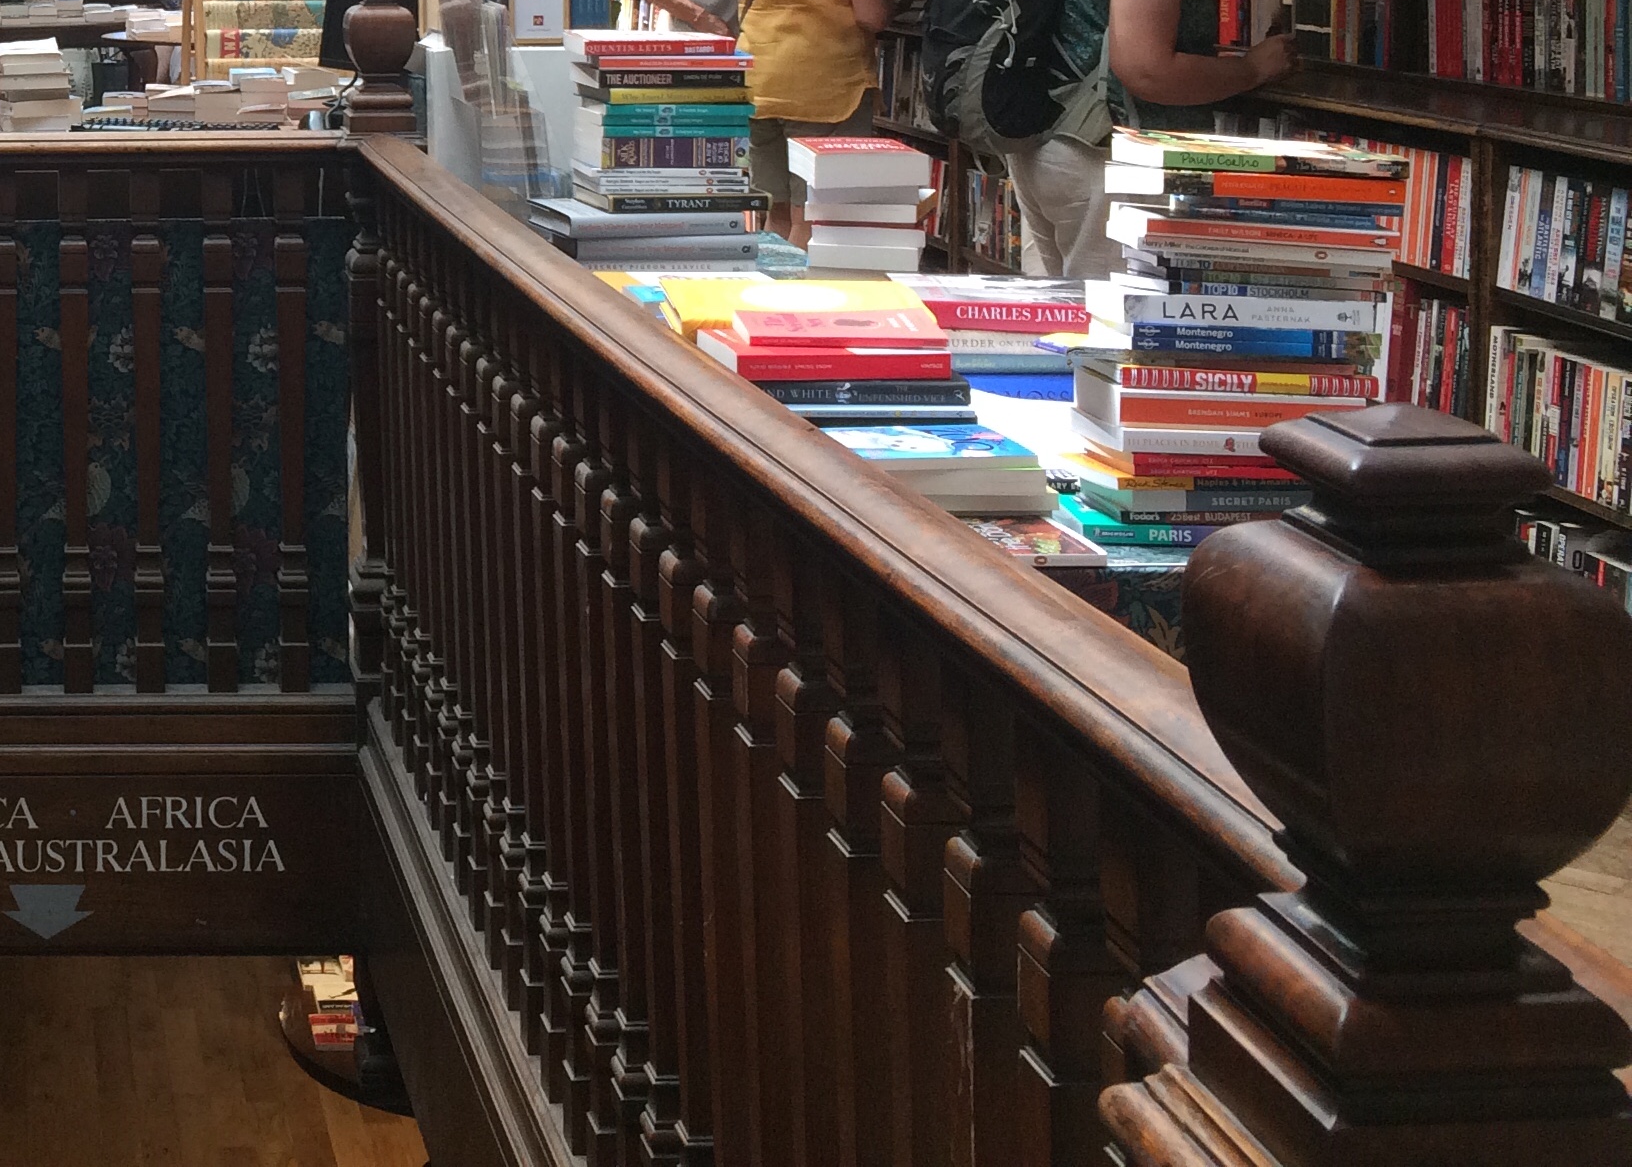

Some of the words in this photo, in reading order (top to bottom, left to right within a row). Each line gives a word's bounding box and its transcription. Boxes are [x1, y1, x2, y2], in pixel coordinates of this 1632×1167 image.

[586, 44, 634, 54] QUENTIN
[638, 44, 672, 52] LETTS
[606, 74, 622, 85] THE
[624, 74, 672, 85] AUCTIONEER
[1180, 153, 1214, 165] Paulo
[1217, 154, 1259, 168] Coelho
[666, 199, 711, 208] TYRANT
[1249, 286, 1309, 299] STOCKHOLM
[956, 305, 1031, 321] CHARLES
[1034, 309, 1087, 323] JAMES
[1163, 301, 1239, 322] LARA
[1176, 327, 1233, 338] Montenegro
[951, 338, 995, 348] URDER
[1175, 341, 1232, 352] Montenegro
[1489, 335, 1499, 399] MOTHERLAND
[1195, 372, 1253, 392] SICILY
[767, 389, 785, 398] ND
[790, 388, 831, 398] WHITE
[1211, 497, 1254, 506] SECRET
[1258, 497, 1291, 506] PARIS
[1205, 513, 1251, 522] BUDAPEST
[1148, 530, 1192, 542] PARIS
[1555, 534, 1567, 567] OPERAT
[105, 796, 268, 829] AFRICA
